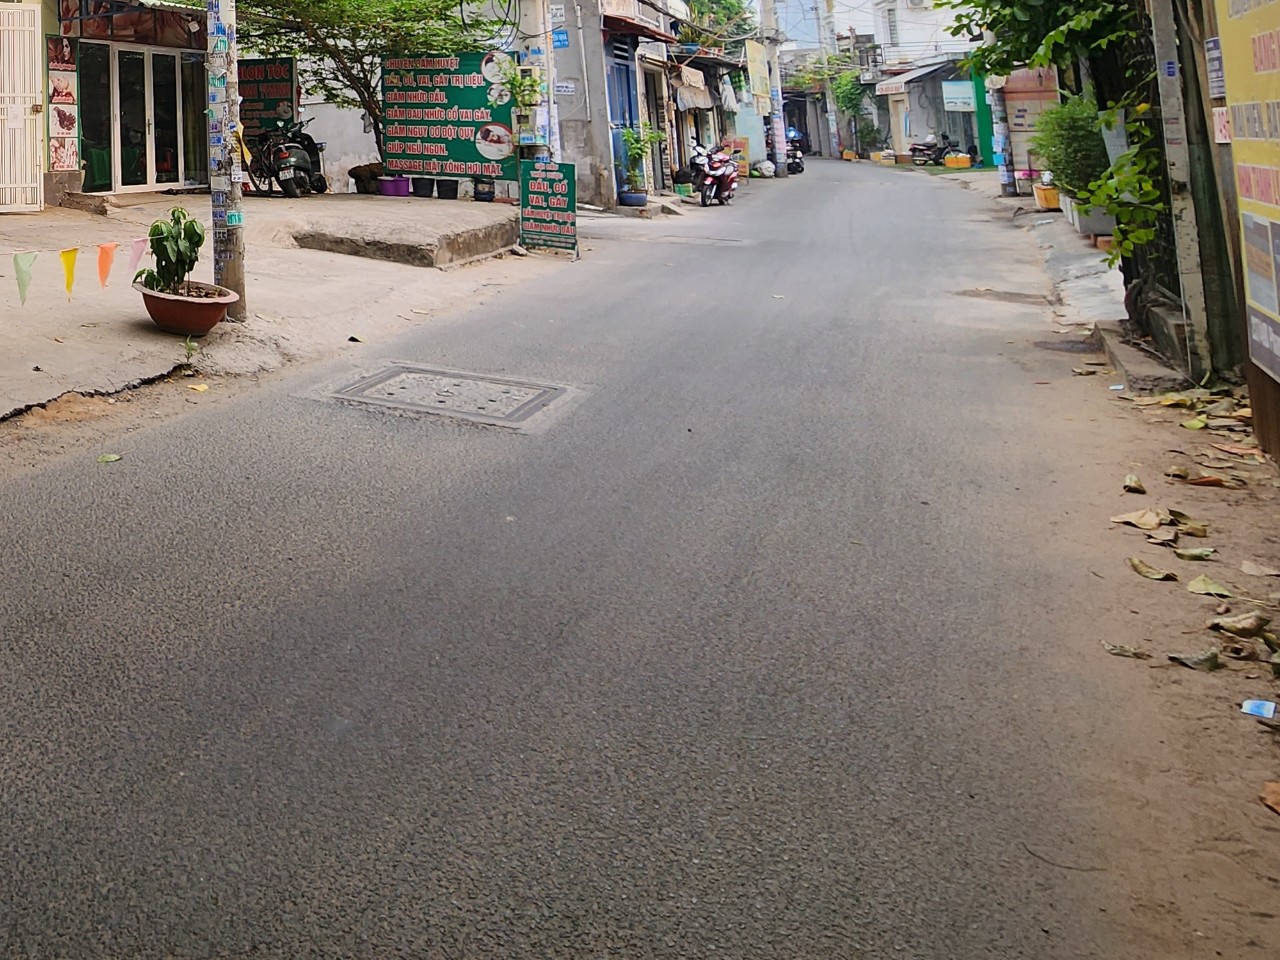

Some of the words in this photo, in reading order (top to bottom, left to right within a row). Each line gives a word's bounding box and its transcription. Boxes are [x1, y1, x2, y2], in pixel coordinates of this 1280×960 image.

[385, 88, 406, 103] GIẢM
[386, 105, 406, 120] GIẢM
[459, 107, 473, 121] VAI
[386, 122, 406, 138] GIẢM
[406, 125, 428, 138] NGUY
[386, 158, 423, 172] MASSAGE
[528, 194, 547, 208] VAI,
